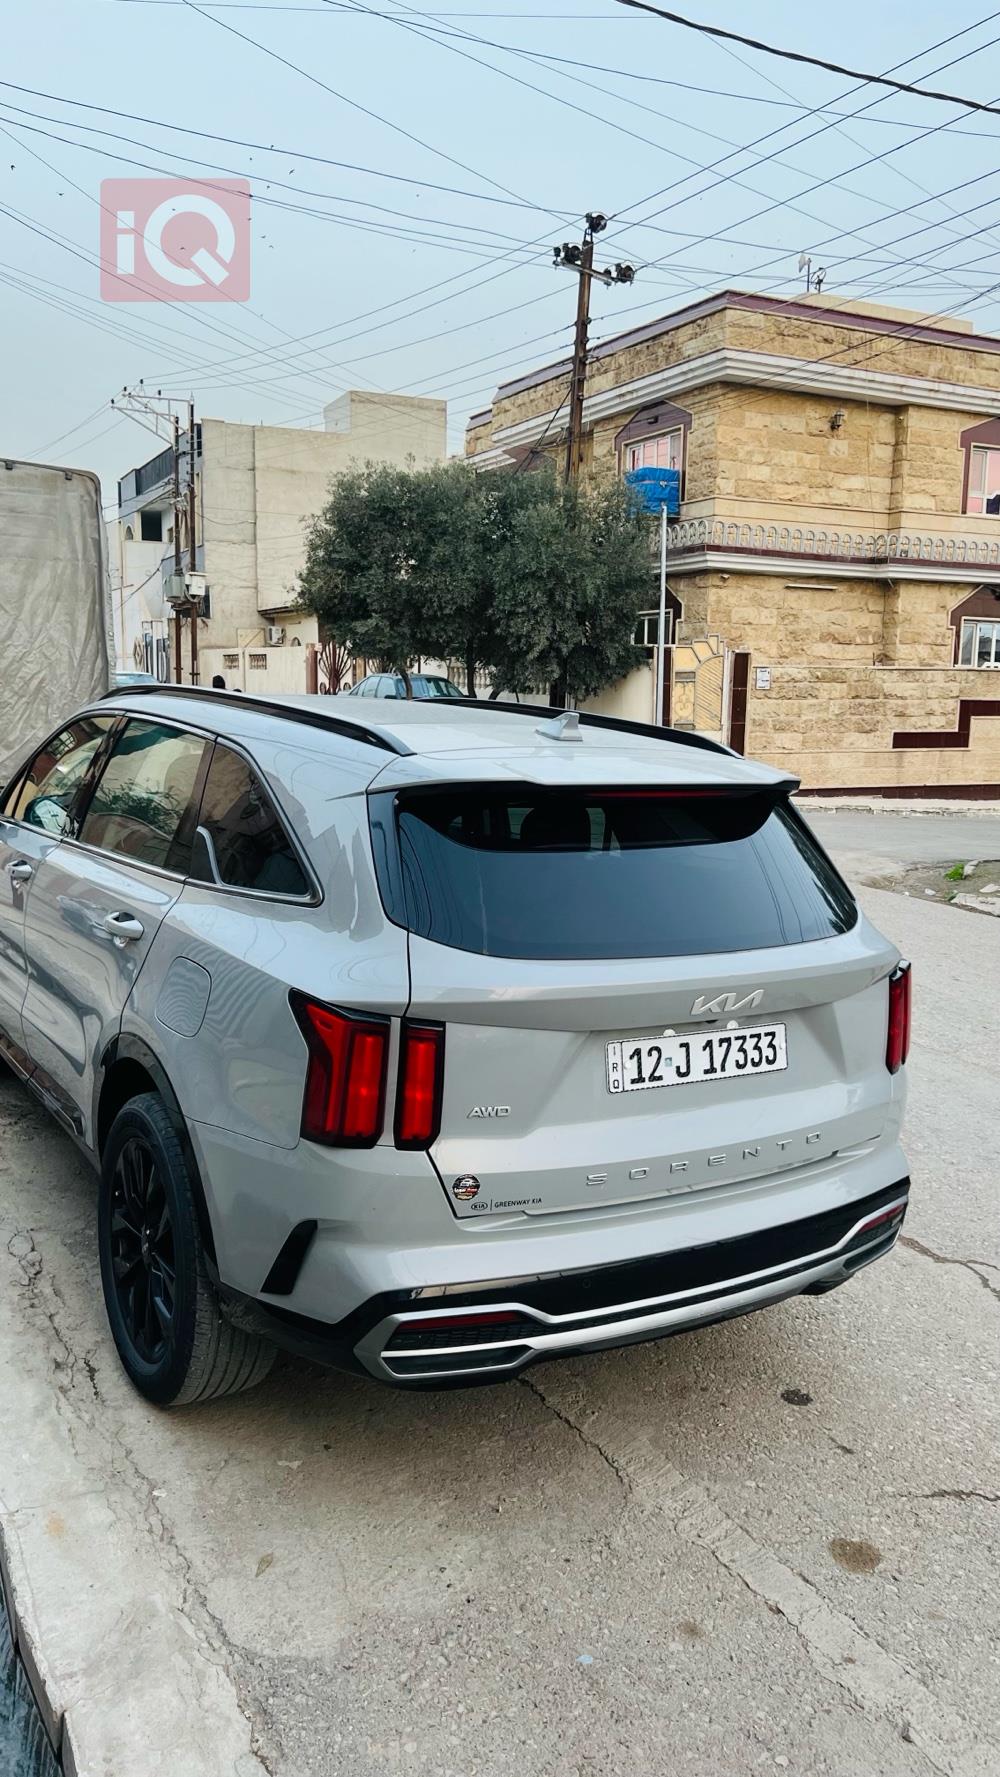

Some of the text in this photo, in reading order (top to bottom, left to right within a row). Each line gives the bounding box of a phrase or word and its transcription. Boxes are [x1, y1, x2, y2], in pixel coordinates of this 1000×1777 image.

[629, 1031, 778, 1084] 12 J 17333
[466, 1106, 511, 1119] AWD
[586, 1131, 821, 1186] SORENTO
[494, 1199, 530, 1208] GREENWAY
